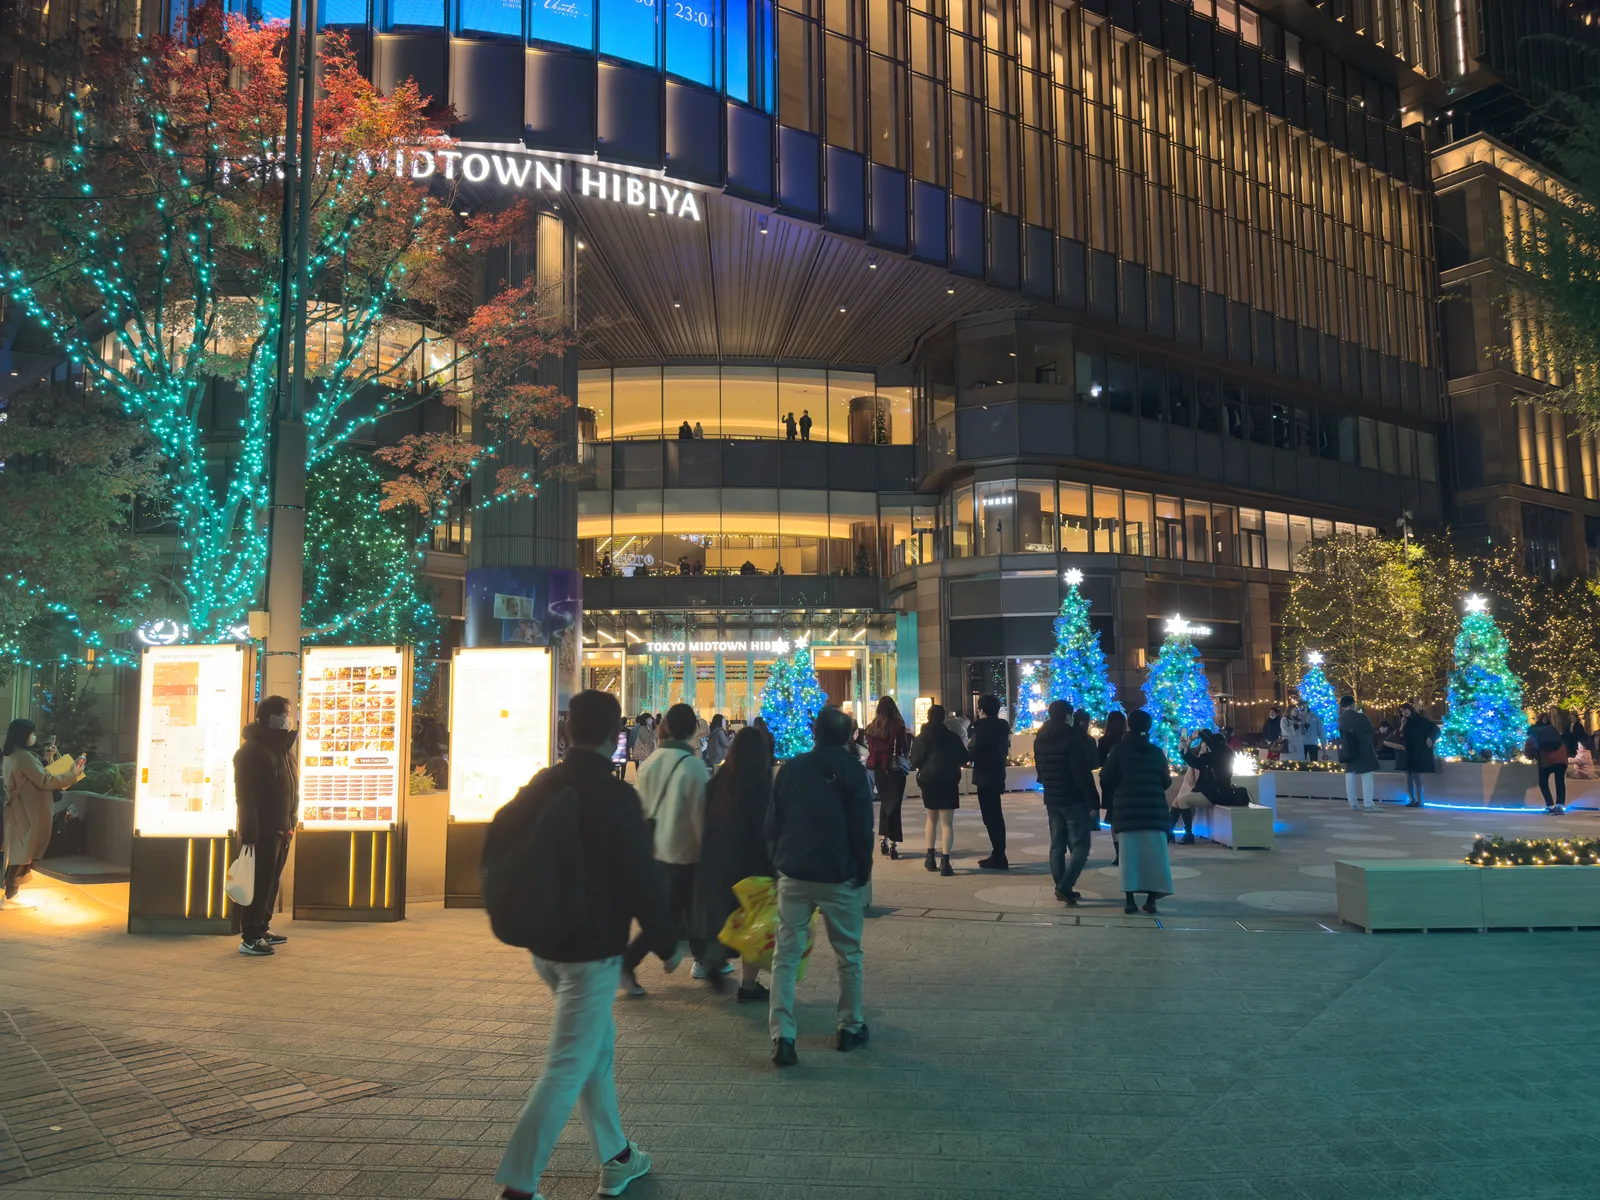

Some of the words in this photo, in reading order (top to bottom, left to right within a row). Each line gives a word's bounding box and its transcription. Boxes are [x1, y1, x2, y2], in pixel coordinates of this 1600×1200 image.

[675, 2, 713, 27] 23:0
[581, 167, 701, 221] HIBIYA
[982, 496, 1013, 506] THREE
[646, 641, 686, 652] TOKYO
[688, 640, 747, 652] MIDTOWN
